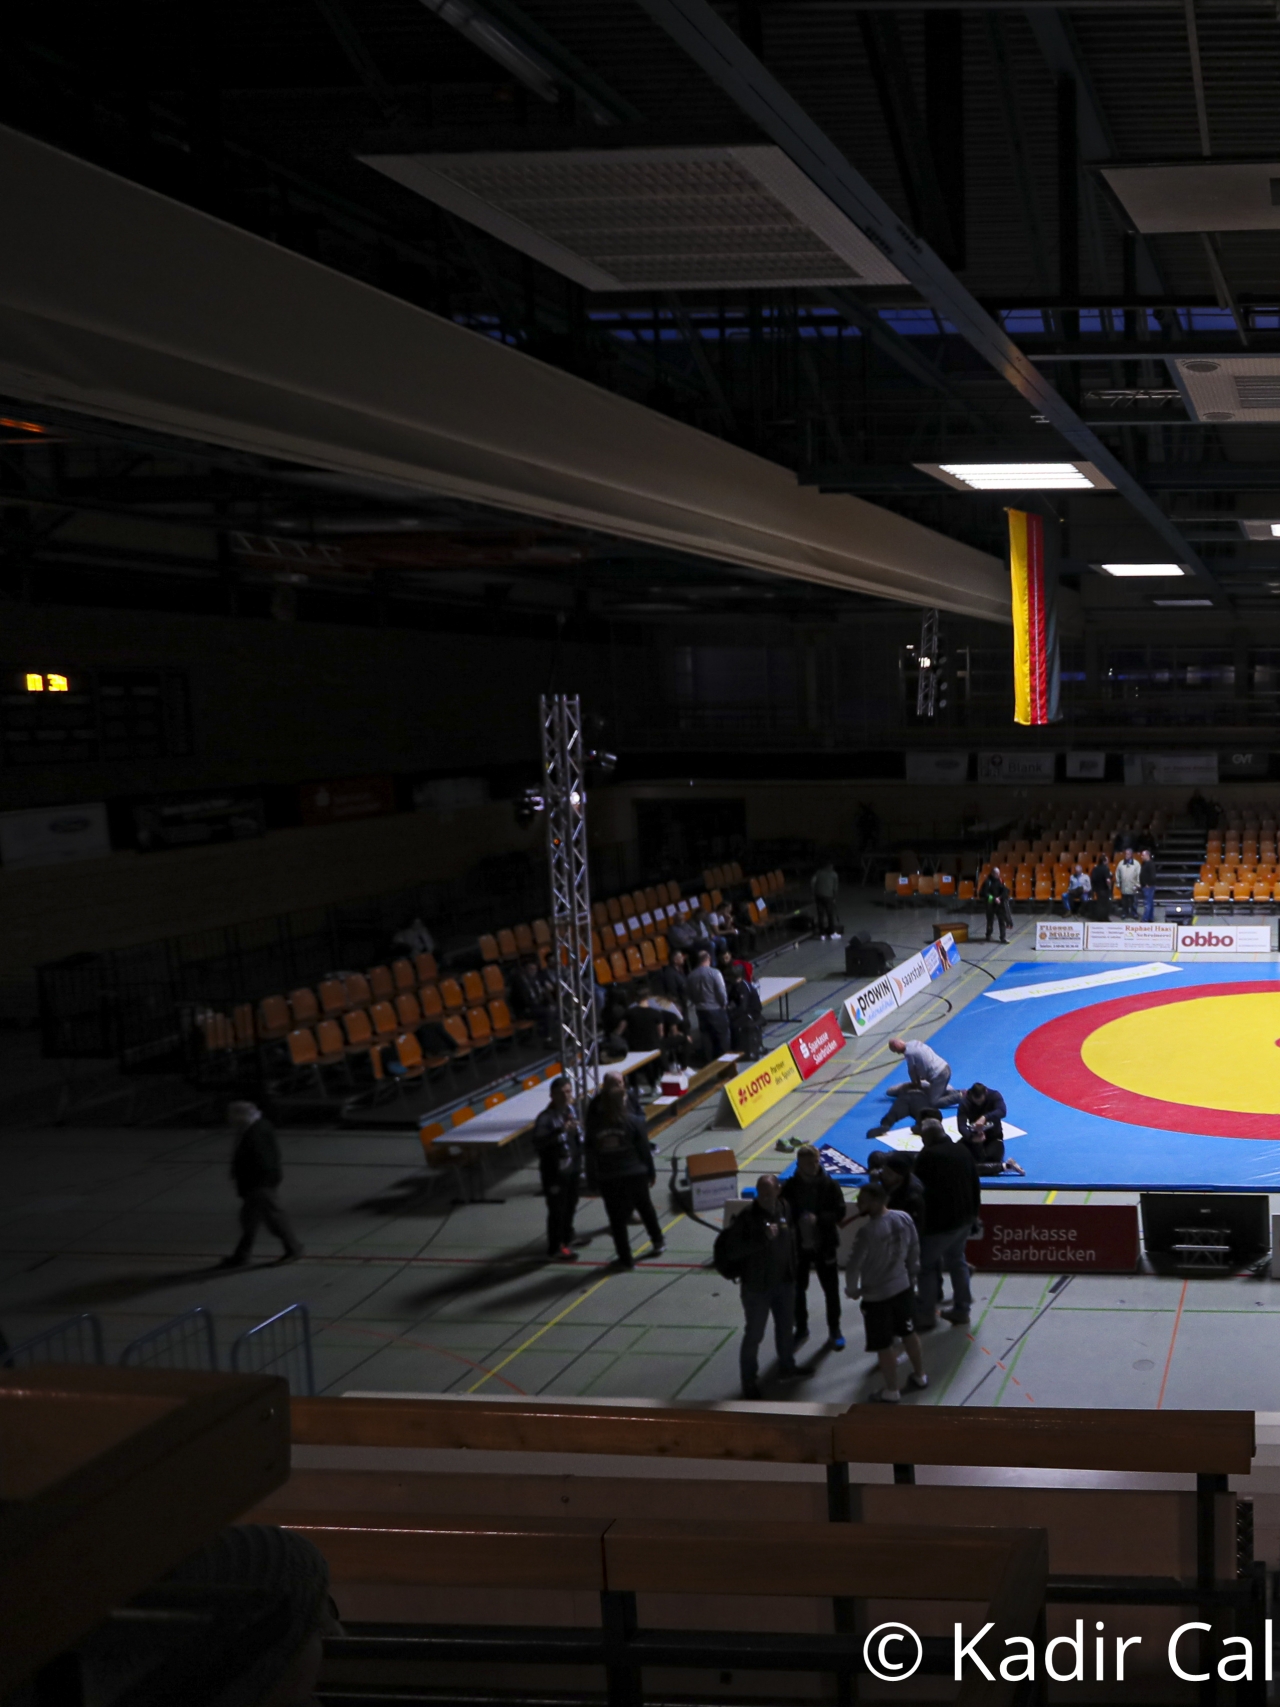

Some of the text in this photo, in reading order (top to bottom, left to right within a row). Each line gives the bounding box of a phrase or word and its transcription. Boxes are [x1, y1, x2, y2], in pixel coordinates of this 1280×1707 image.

[1008, 762, 1042, 773] Blank
[1125, 924, 1153, 933] Raphael
[1181, 931, 1234, 947] obbo
[901, 960, 926, 987] saarstahl
[808, 1031, 829, 1053] Sparkasse
[813, 1039, 838, 1065] Saarbrücken
[745, 1071, 771, 1098] LOTTO
[993, 1225, 1078, 1243] Sparkasse
[993, 1245, 1096, 1262] Saarbrücken
